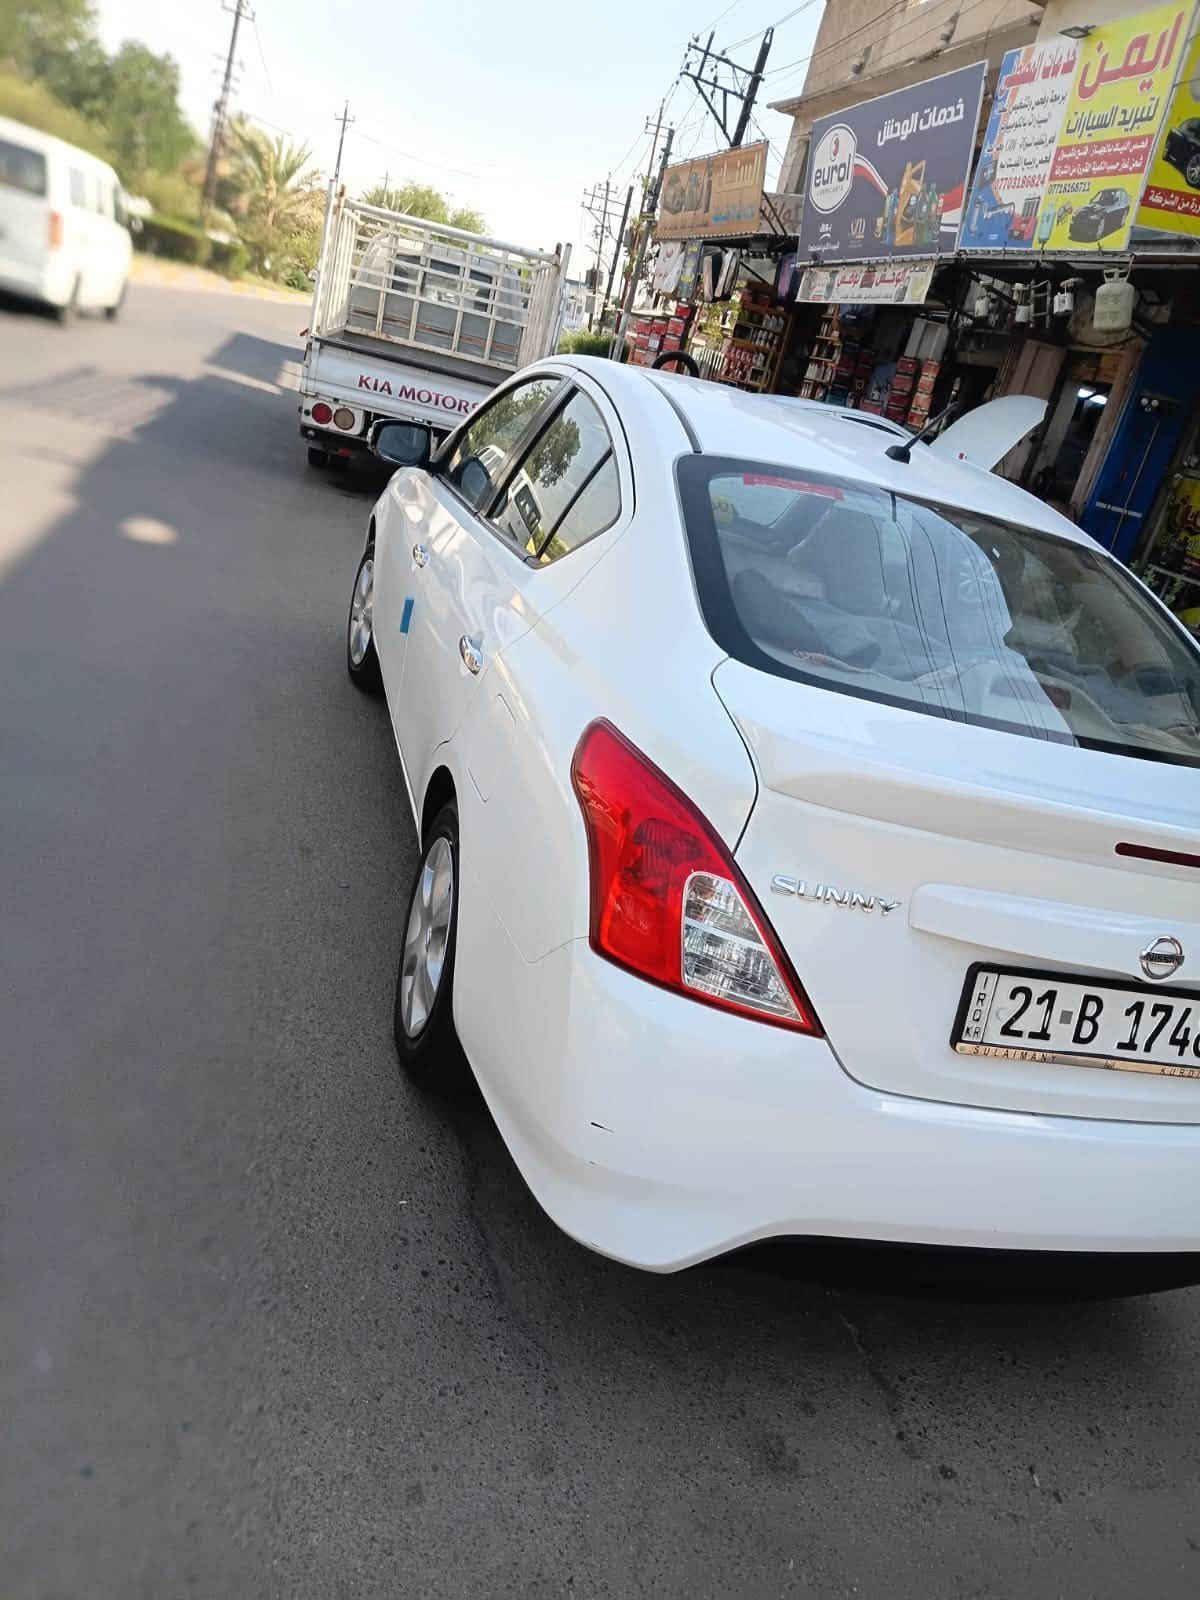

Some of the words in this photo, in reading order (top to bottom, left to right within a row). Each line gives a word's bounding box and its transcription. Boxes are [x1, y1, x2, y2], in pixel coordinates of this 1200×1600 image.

[1078, 11, 1185, 100] ايمن
[877, 112, 920, 147] الوحش
[920, 98, 965, 132] خدمات
[1066, 106, 1116, 139] السيارات
[814, 154, 852, 187] eurol
[1149, 189, 1178, 209] الشركة
[358, 374, 394, 396] KIA
[770, 873, 902, 916] SUNNY
[999, 984, 1058, 1041] 21
[1071, 993, 1104, 1046] B
